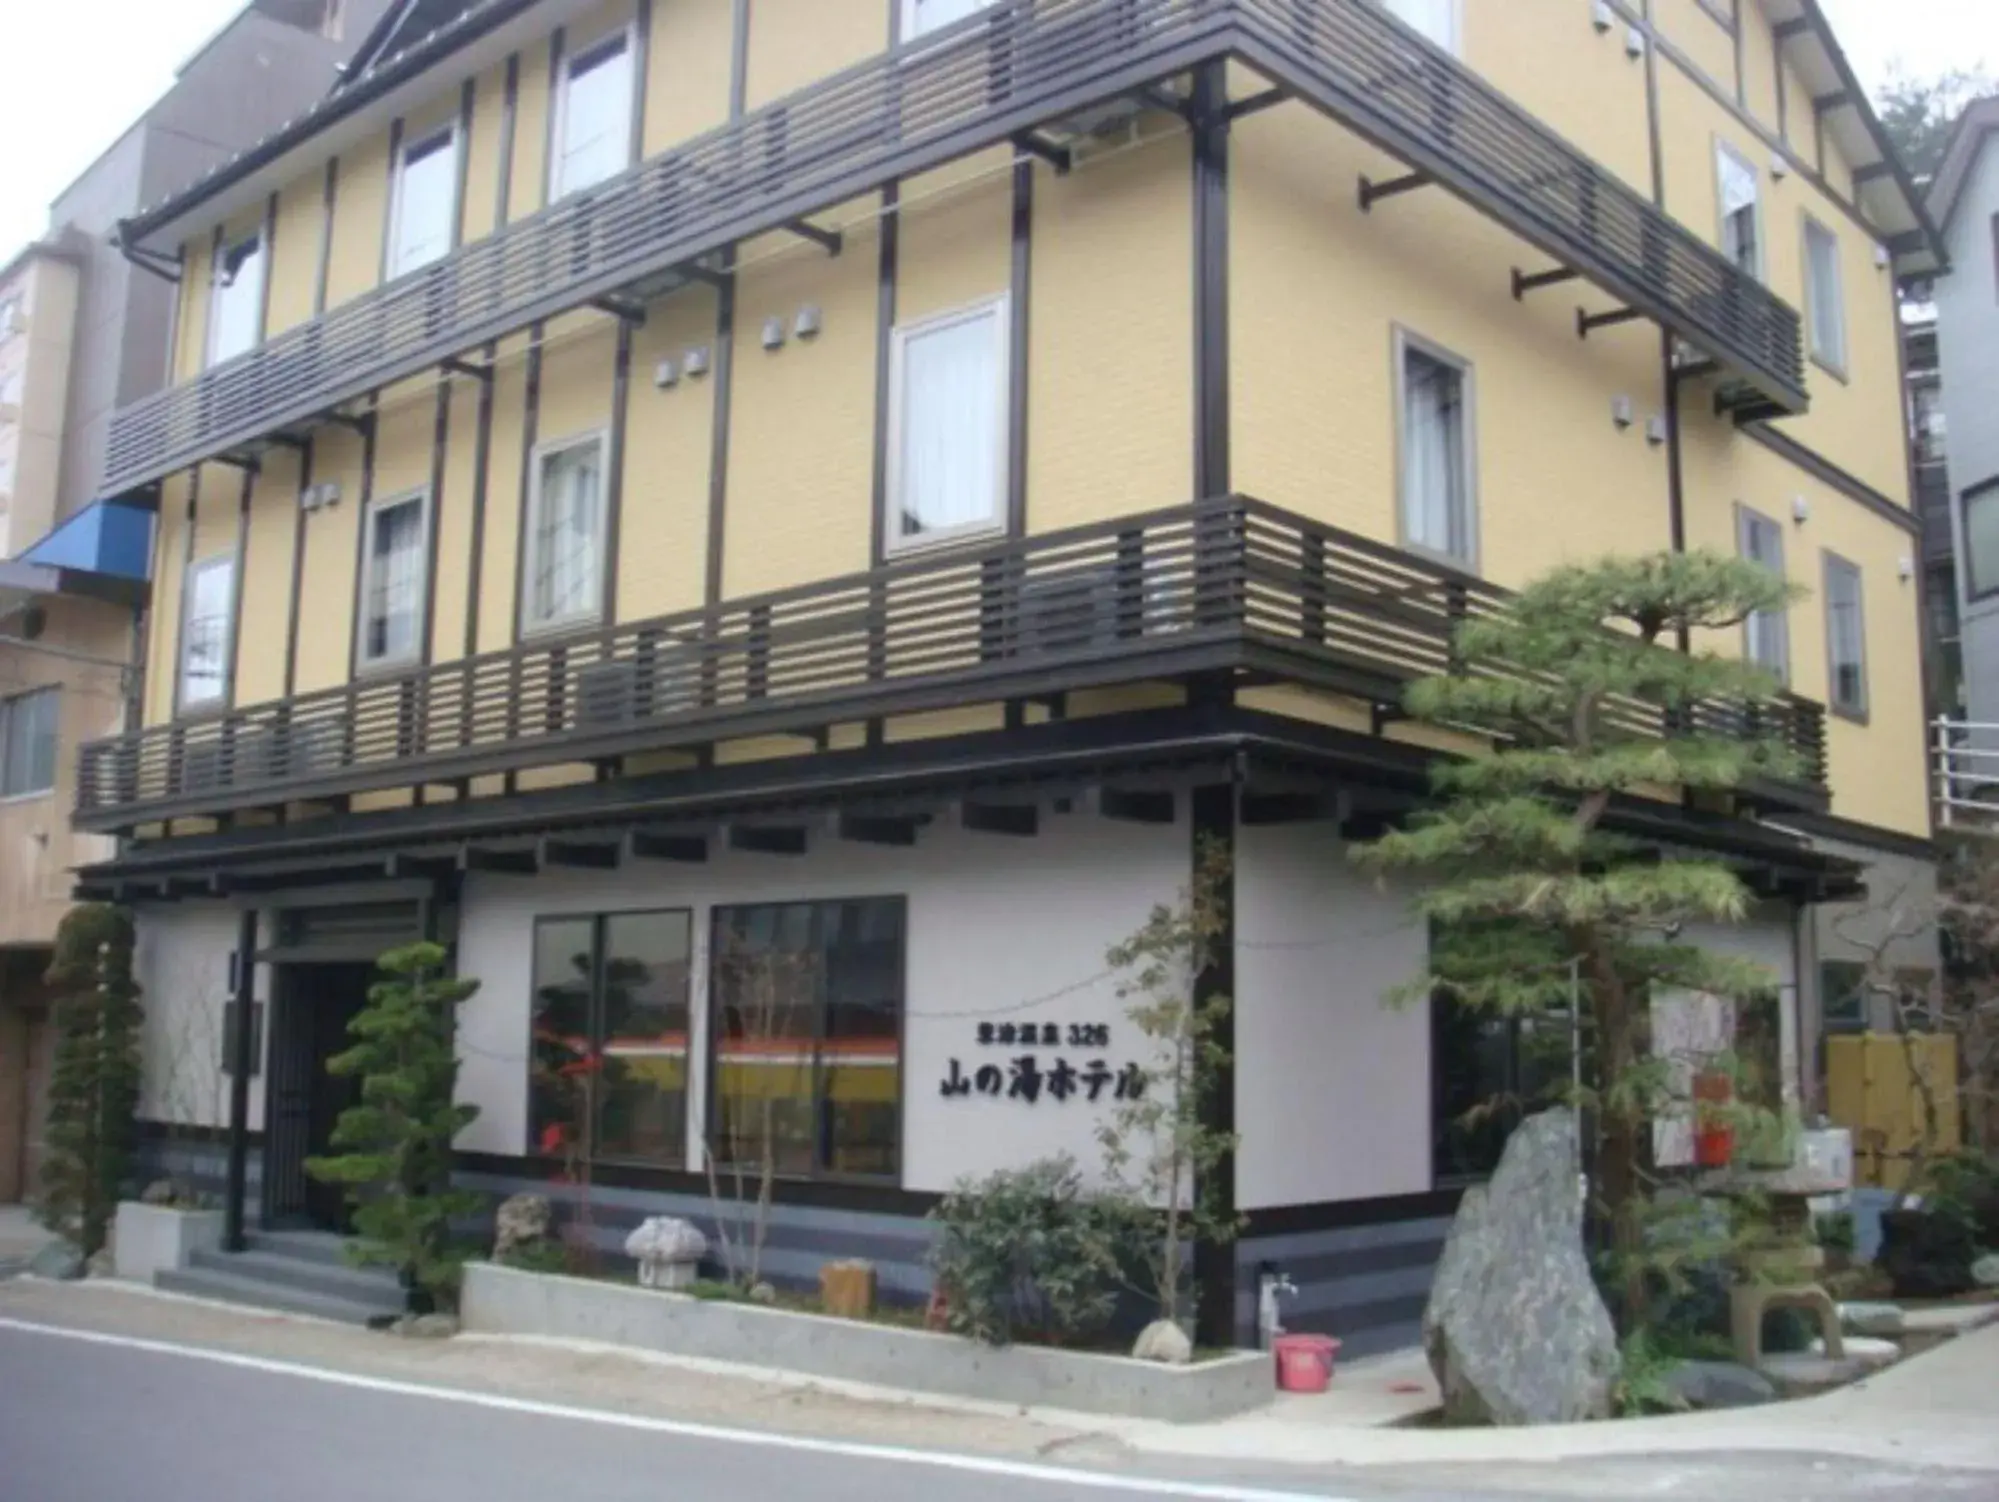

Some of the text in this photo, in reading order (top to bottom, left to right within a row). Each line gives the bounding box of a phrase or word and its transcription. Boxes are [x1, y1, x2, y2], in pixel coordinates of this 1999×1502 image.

[939, 1055, 1149, 1104] 山の湯ホテル
